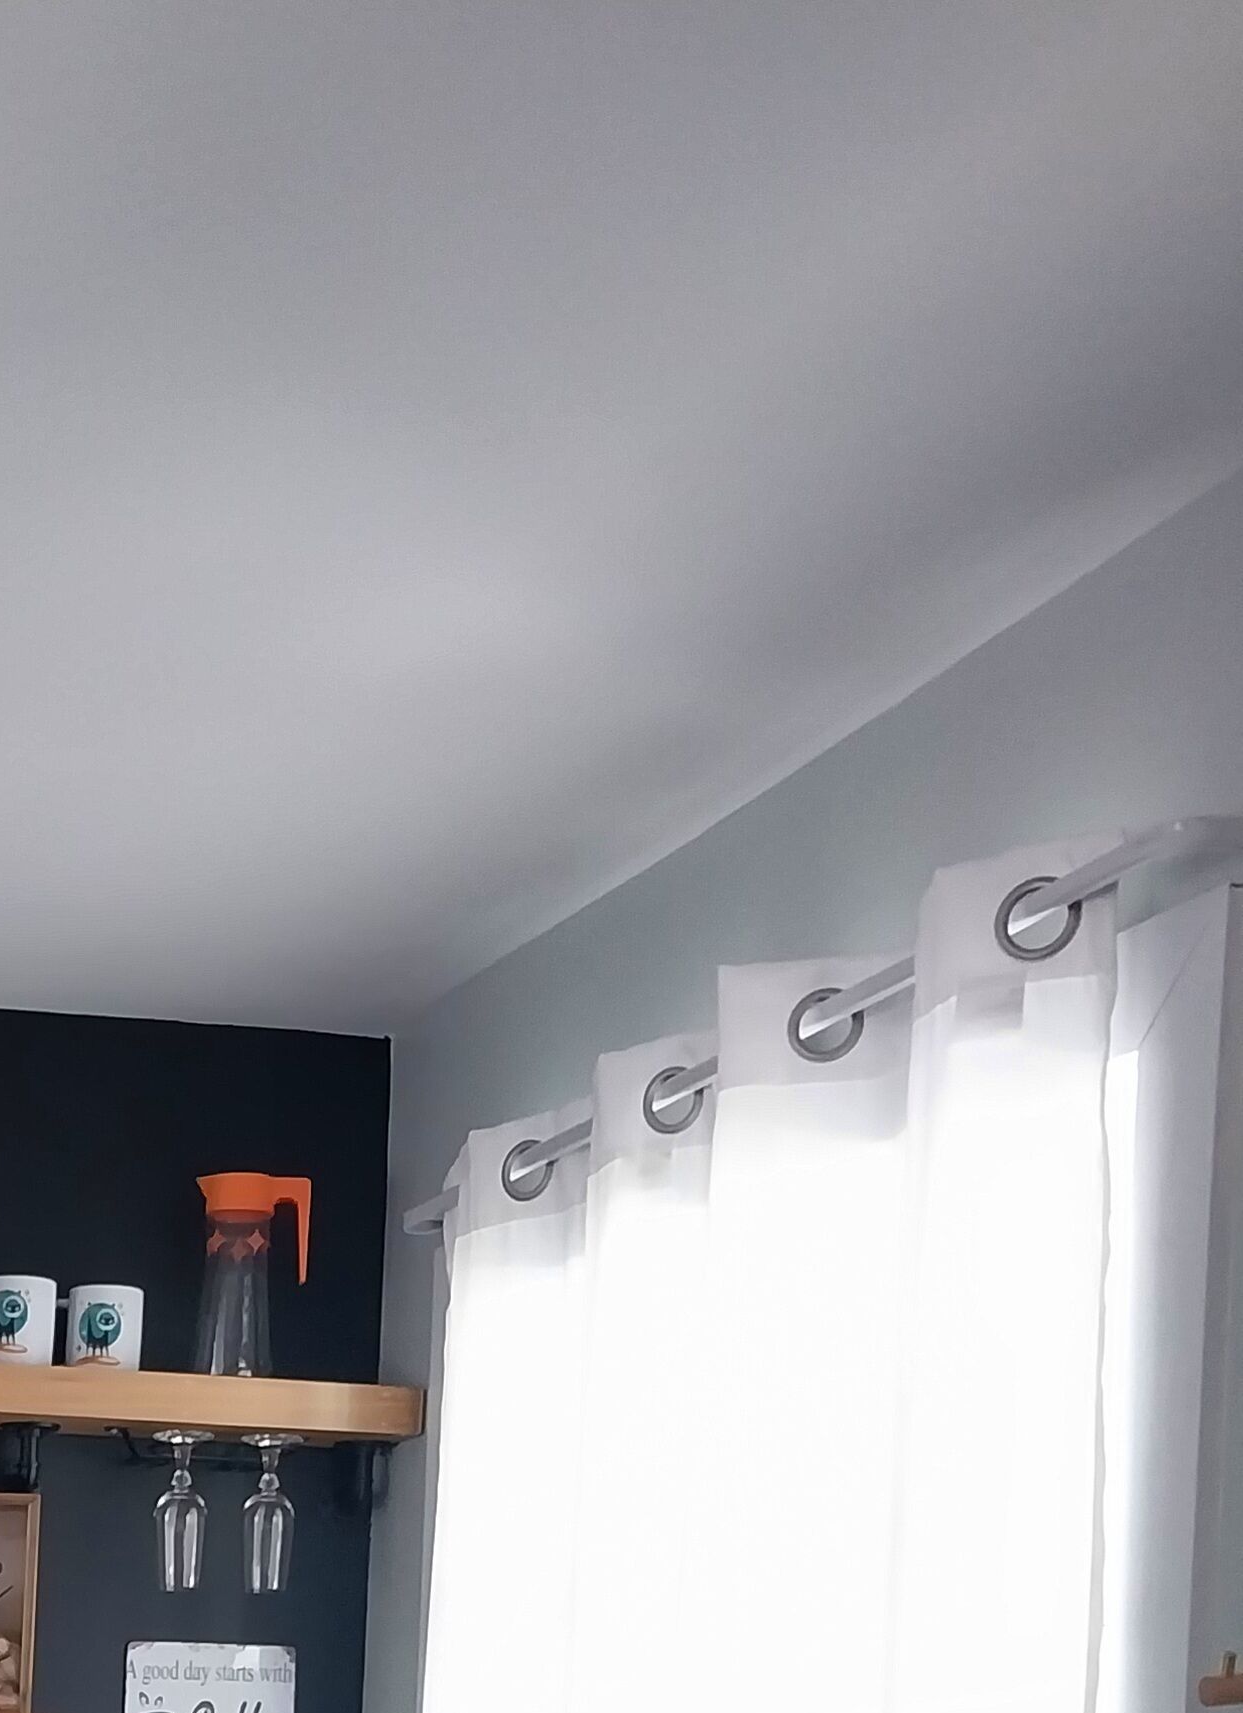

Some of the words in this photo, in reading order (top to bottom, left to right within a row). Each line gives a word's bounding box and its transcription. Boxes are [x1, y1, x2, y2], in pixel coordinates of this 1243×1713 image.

[126, 1660, 137, 1679] A
[141, 1660, 180, 1685] good
[183, 1661, 209, 1686] day
[214, 1665, 255, 1683] starts
[258, 1662, 293, 1684] with
